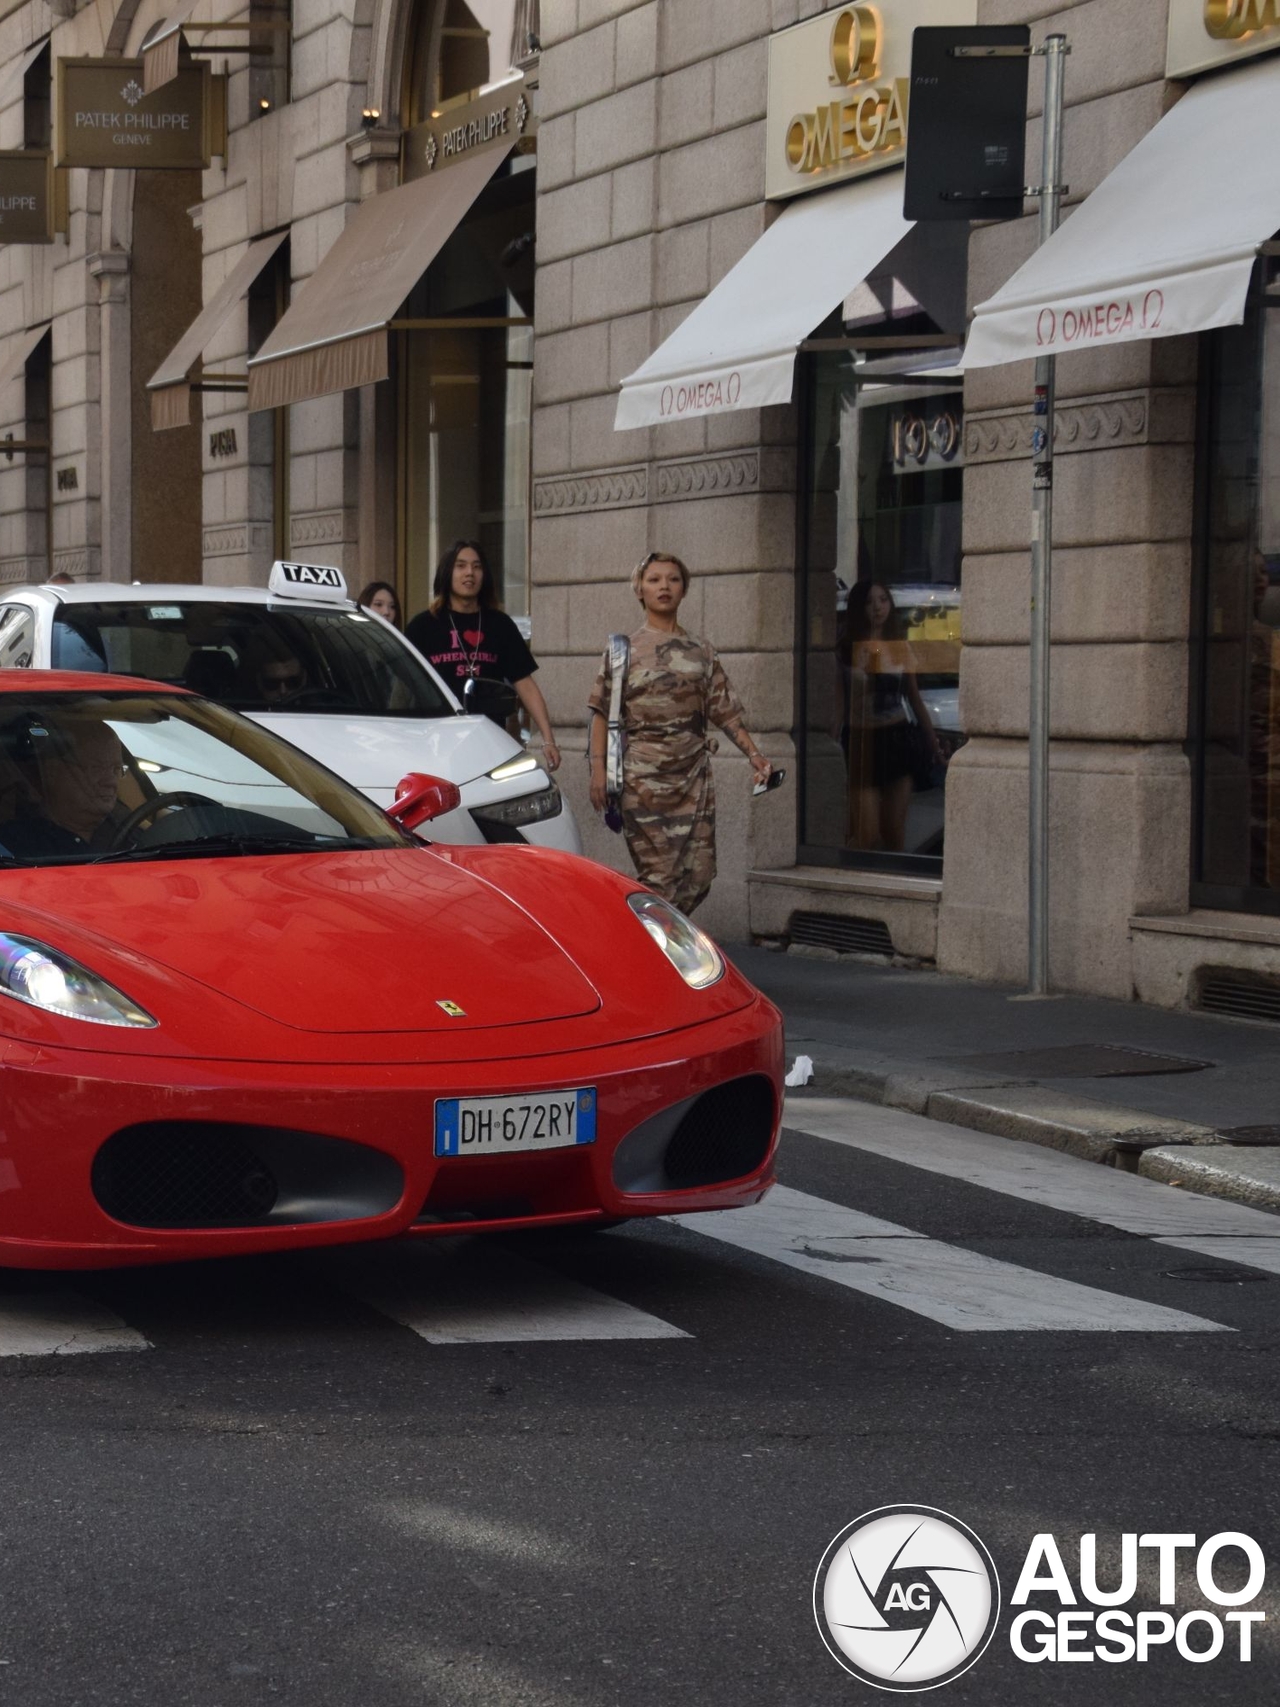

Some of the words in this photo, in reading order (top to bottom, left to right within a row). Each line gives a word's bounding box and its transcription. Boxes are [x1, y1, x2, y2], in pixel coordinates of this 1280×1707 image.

[75, 112, 120, 128] PATEK
[124, 113, 190, 130] PHILIPPE
[442, 127, 468, 158] PATEK
[469, 107, 508, 147] PHILIPPE
[785, 77, 909, 173] OMEGA
[1062, 302, 1134, 342] OMEGA
[677, 381, 722, 413] OMEGA
[283, 565, 339, 586] TAXI
[450, 629, 460, 649] I
[430, 652, 467, 665] WHEN
